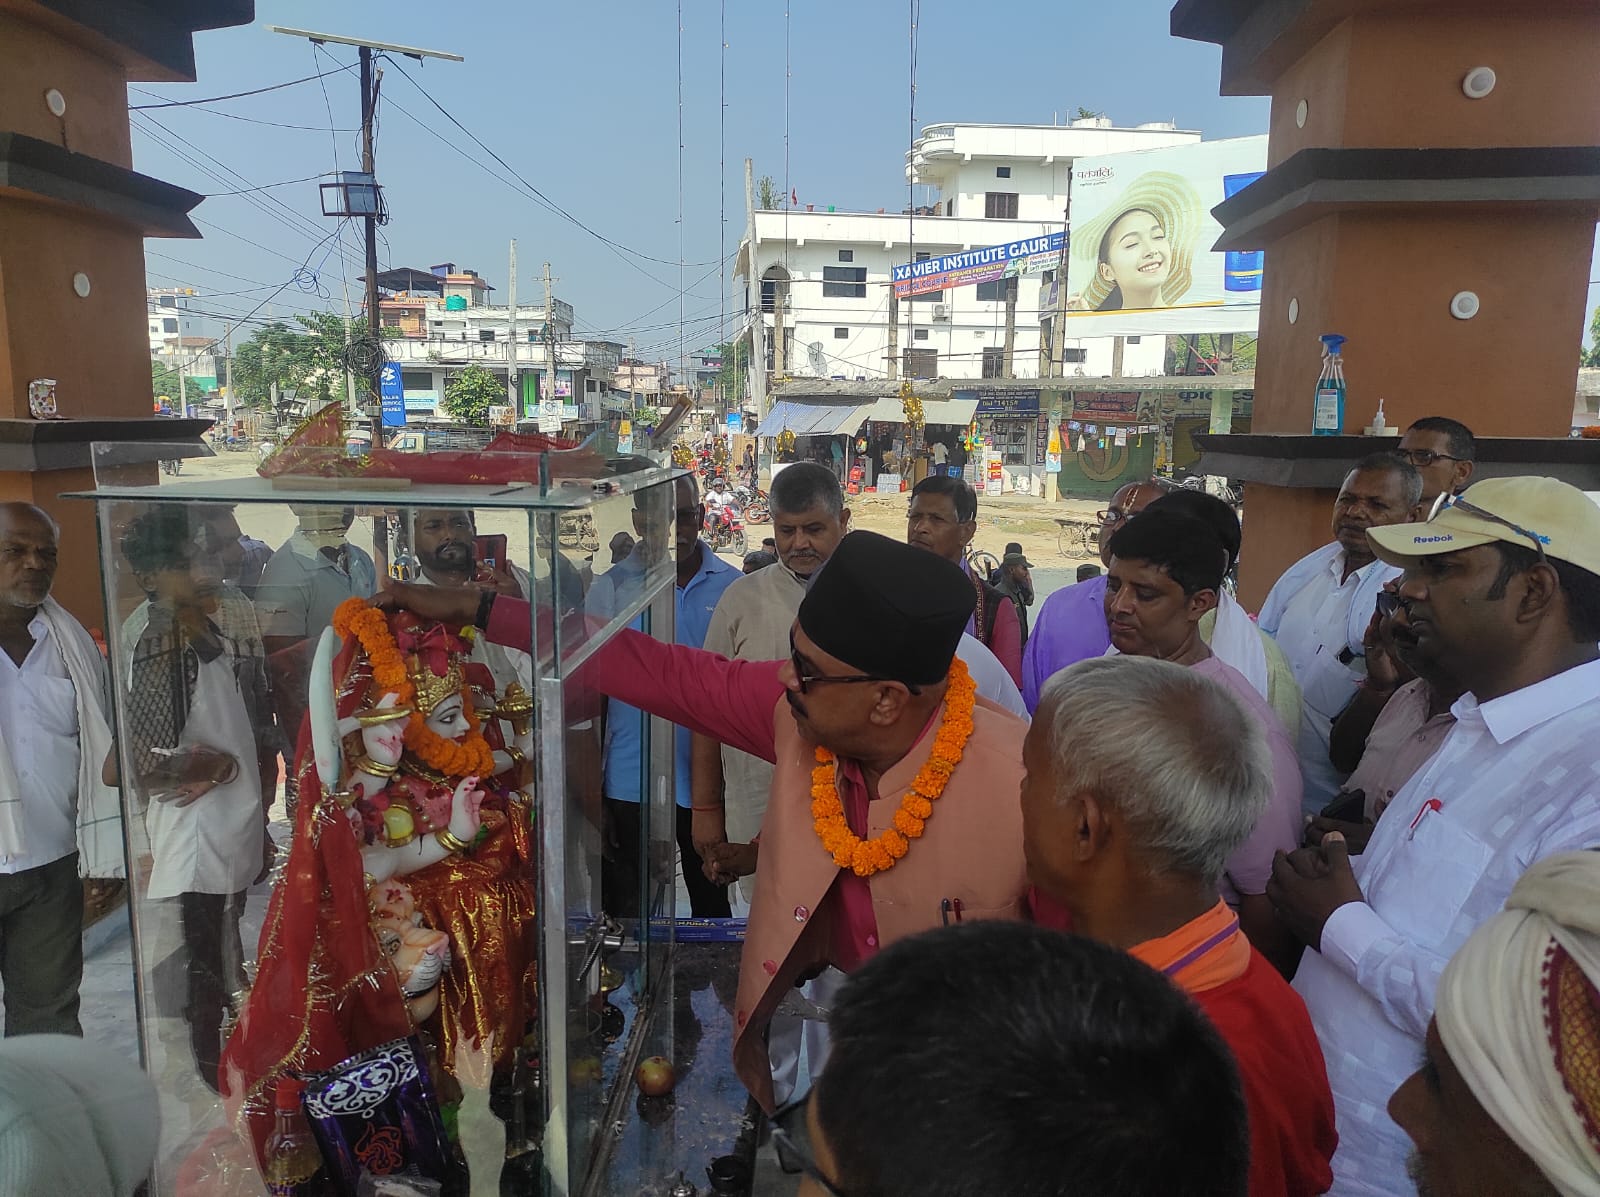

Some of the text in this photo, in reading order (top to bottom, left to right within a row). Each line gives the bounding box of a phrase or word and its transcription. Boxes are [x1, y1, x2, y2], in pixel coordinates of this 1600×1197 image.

[896, 261, 940, 280] XAVIER
[943, 247, 1006, 269] INSTITUTE
[1008, 238, 1050, 258] GAUR
[1413, 534, 1454, 544] Reebok
